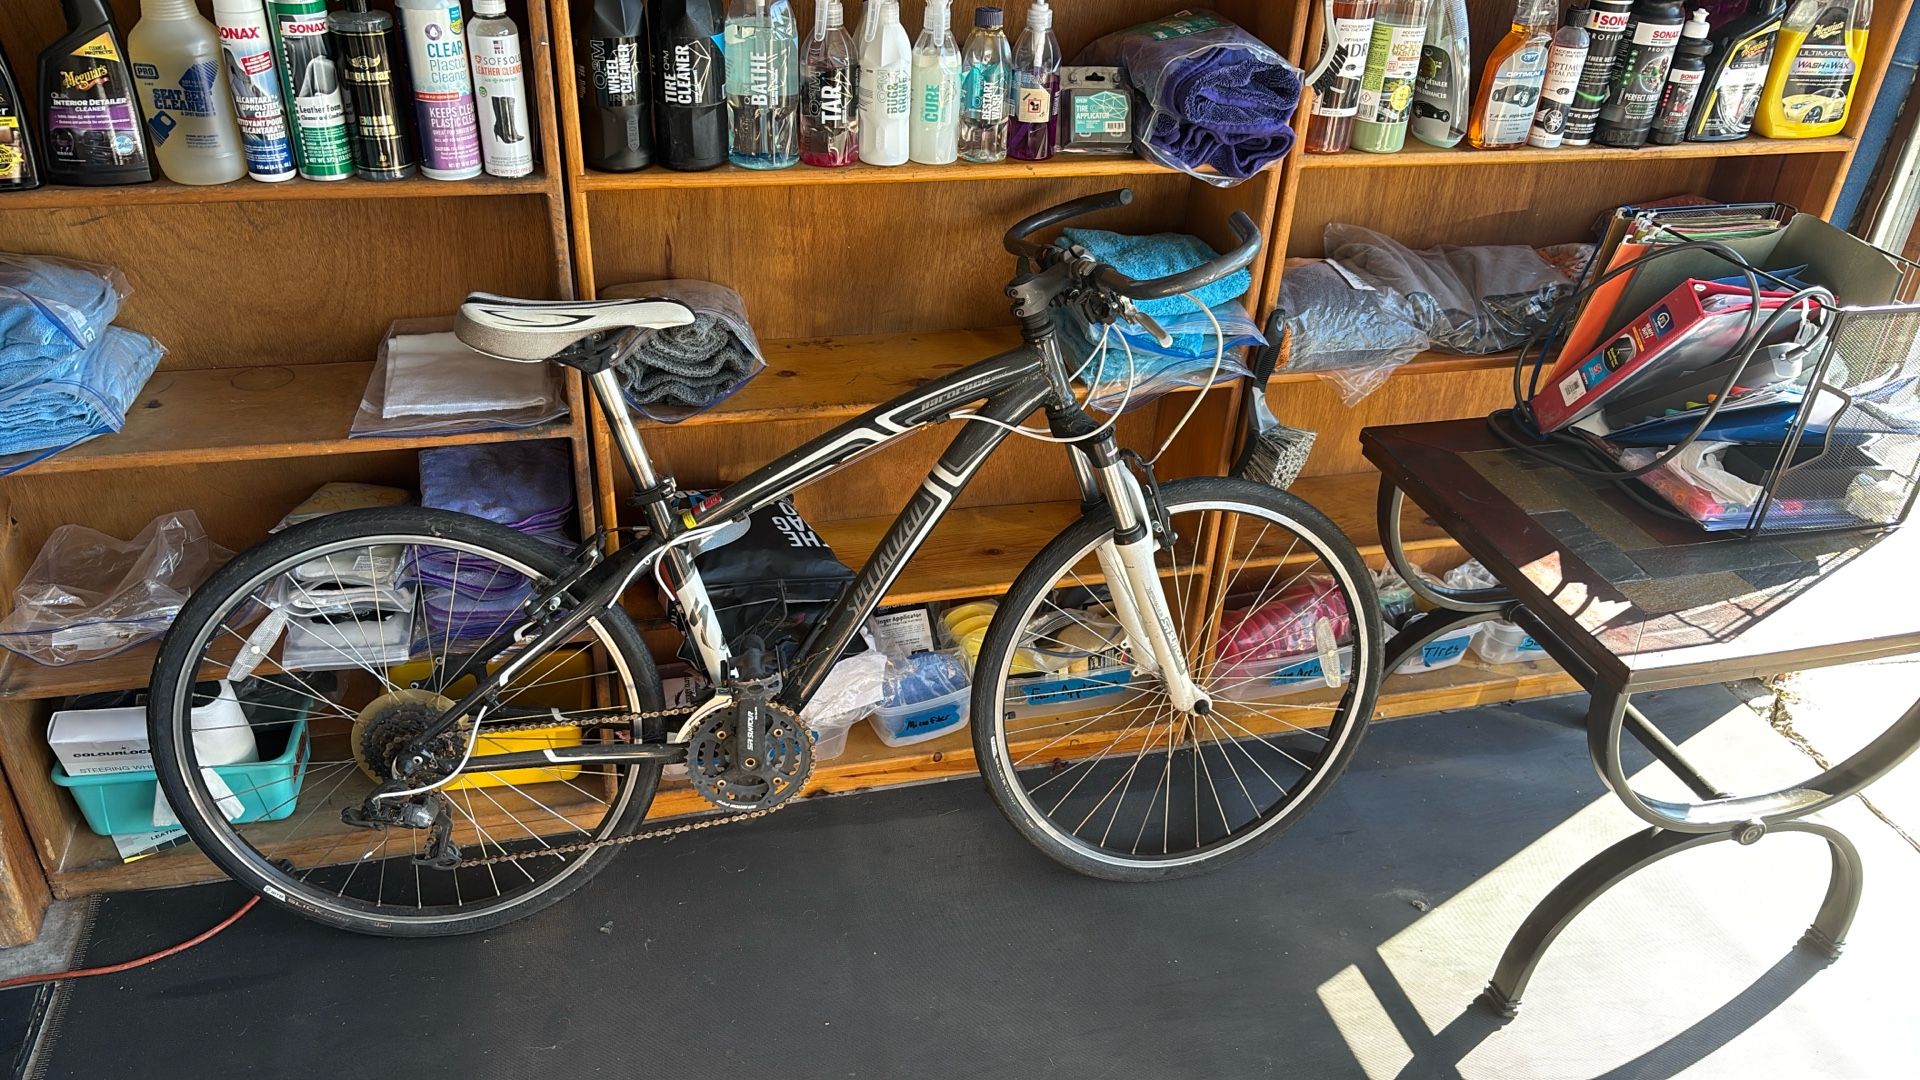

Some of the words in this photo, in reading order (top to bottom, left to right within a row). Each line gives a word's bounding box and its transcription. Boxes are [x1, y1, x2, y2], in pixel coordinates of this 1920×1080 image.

[288, 22, 327, 34] SONAX
[427, 40, 464, 58] CLEAR
[429, 57, 466, 71] Plastic
[476, 65, 501, 76] LEATHER
[501, 63, 522, 76] CLEANE
[618, 43, 633, 94] CLEANER
[1549, 61, 1582, 72] OPTIMU
[60, 65, 108, 89] Meguiar's
[136, 67, 154, 76] PRO
[606, 56, 621, 94] WHEEL
[675, 45, 693, 105] CLEANER
[1506, 69, 1544, 78] OPTIMUM
[750, 52, 768, 106] BATHE
[153, 88, 182, 100] SEAT
[664, 72, 678, 103] TIRE
[89, 97, 127, 106] DETAILER
[924, 84, 940, 123] CURE
[981, 81, 994, 120] RESTART
[1624, 93, 1646, 102] PERFECT
[299, 105, 325, 114] Leather
[326, 104, 341, 113] Foam
[821, 85, 842, 125] TAR
[991, 94, 1003, 120] WASH
[1076, 104, 1089, 113] TIRE
[429, 106, 457, 119] KEEPS
[1076, 112, 1110, 120] APPLICATOR
[431, 116, 461, 128] PLASTIC
[462, 112, 476, 125] CLEA
[771, 515, 806, 532] AG
[782, 531, 830, 548] HE
[847, 499, 925, 613] SPECIALIZED
[892, 612, 922, 623] Applicator
[746, 739, 754, 752] SR
[79, 765, 130, 774] STEERING
